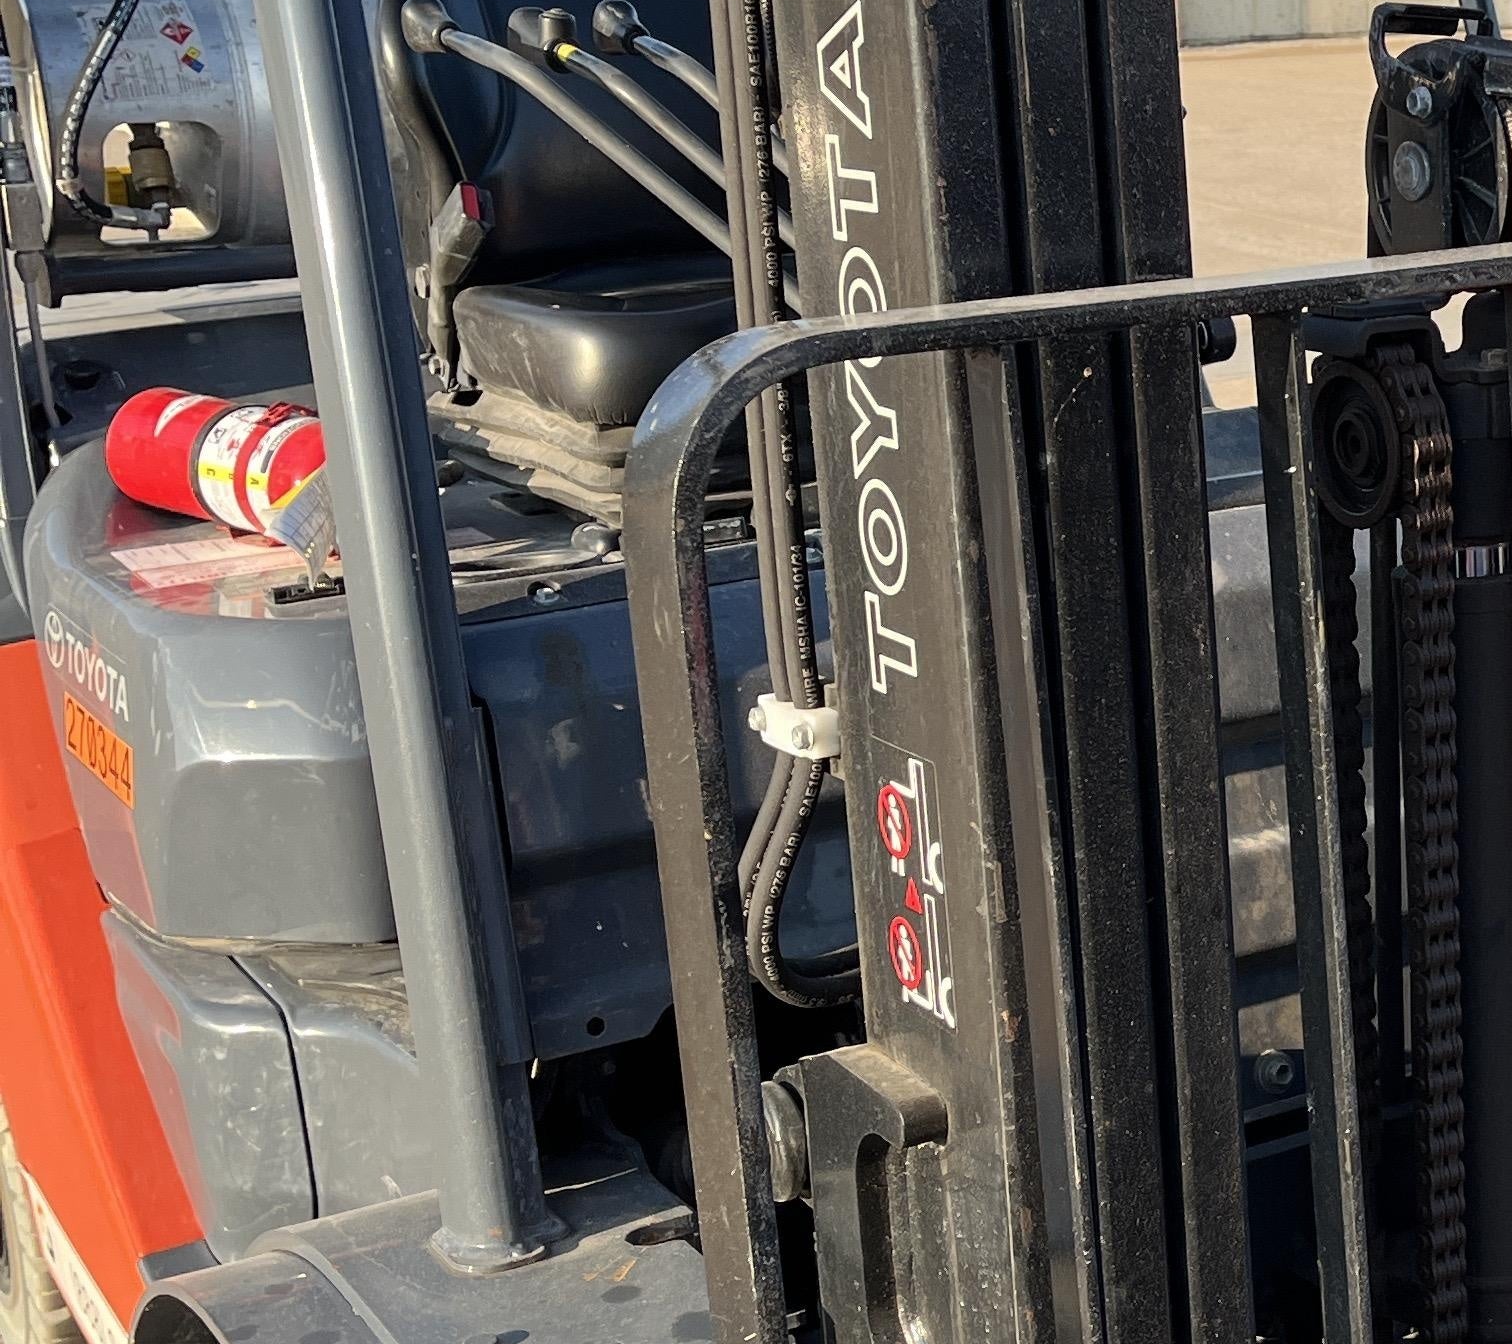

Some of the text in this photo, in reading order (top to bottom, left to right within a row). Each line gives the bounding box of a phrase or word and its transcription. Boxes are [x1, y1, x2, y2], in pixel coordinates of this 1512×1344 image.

[751, 105, 768, 146] BAR)
[762, 222, 777, 247] PSI
[816, 0, 918, 695] TOYOTA
[780, 432, 795, 463] 6TX
[790, 544, 808, 612] IC-101/34
[795, 615, 813, 660] MSHA
[65, 632, 129, 723] TOYOTA
[801, 667, 820, 708] WIRE
[66, 698, 131, 802] 270344
[778, 831, 802, 867] BAR)
[761, 905, 776, 929] WP
[761, 932, 775, 953] PSI
[762, 955, 781, 982] 4000
